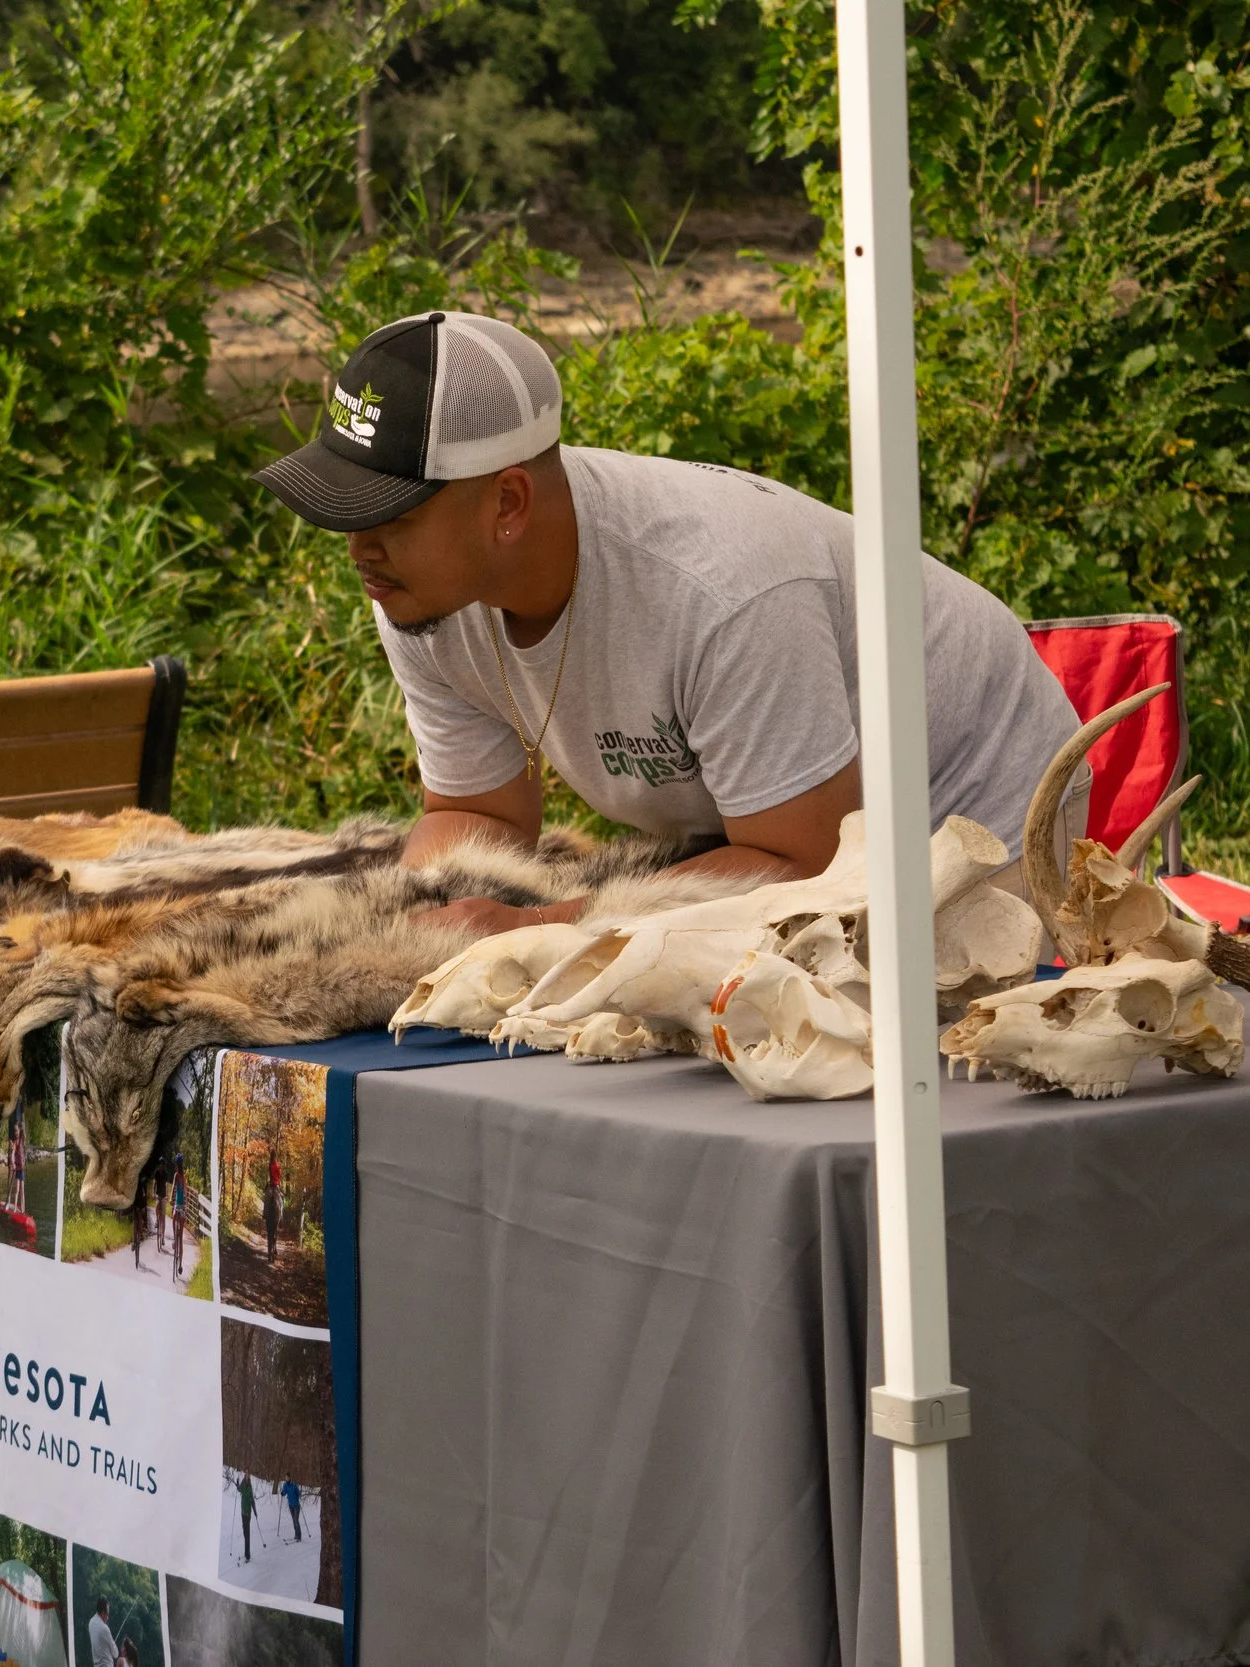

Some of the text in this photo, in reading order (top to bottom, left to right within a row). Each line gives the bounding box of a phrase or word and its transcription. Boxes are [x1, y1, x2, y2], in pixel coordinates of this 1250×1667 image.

[329, 398, 351, 428] rps
[334, 381, 381, 422] ervation
[601, 751, 676, 788] corps
[37, 1429, 80, 1468] AND
[90, 1445, 158, 1495] TRAILS
